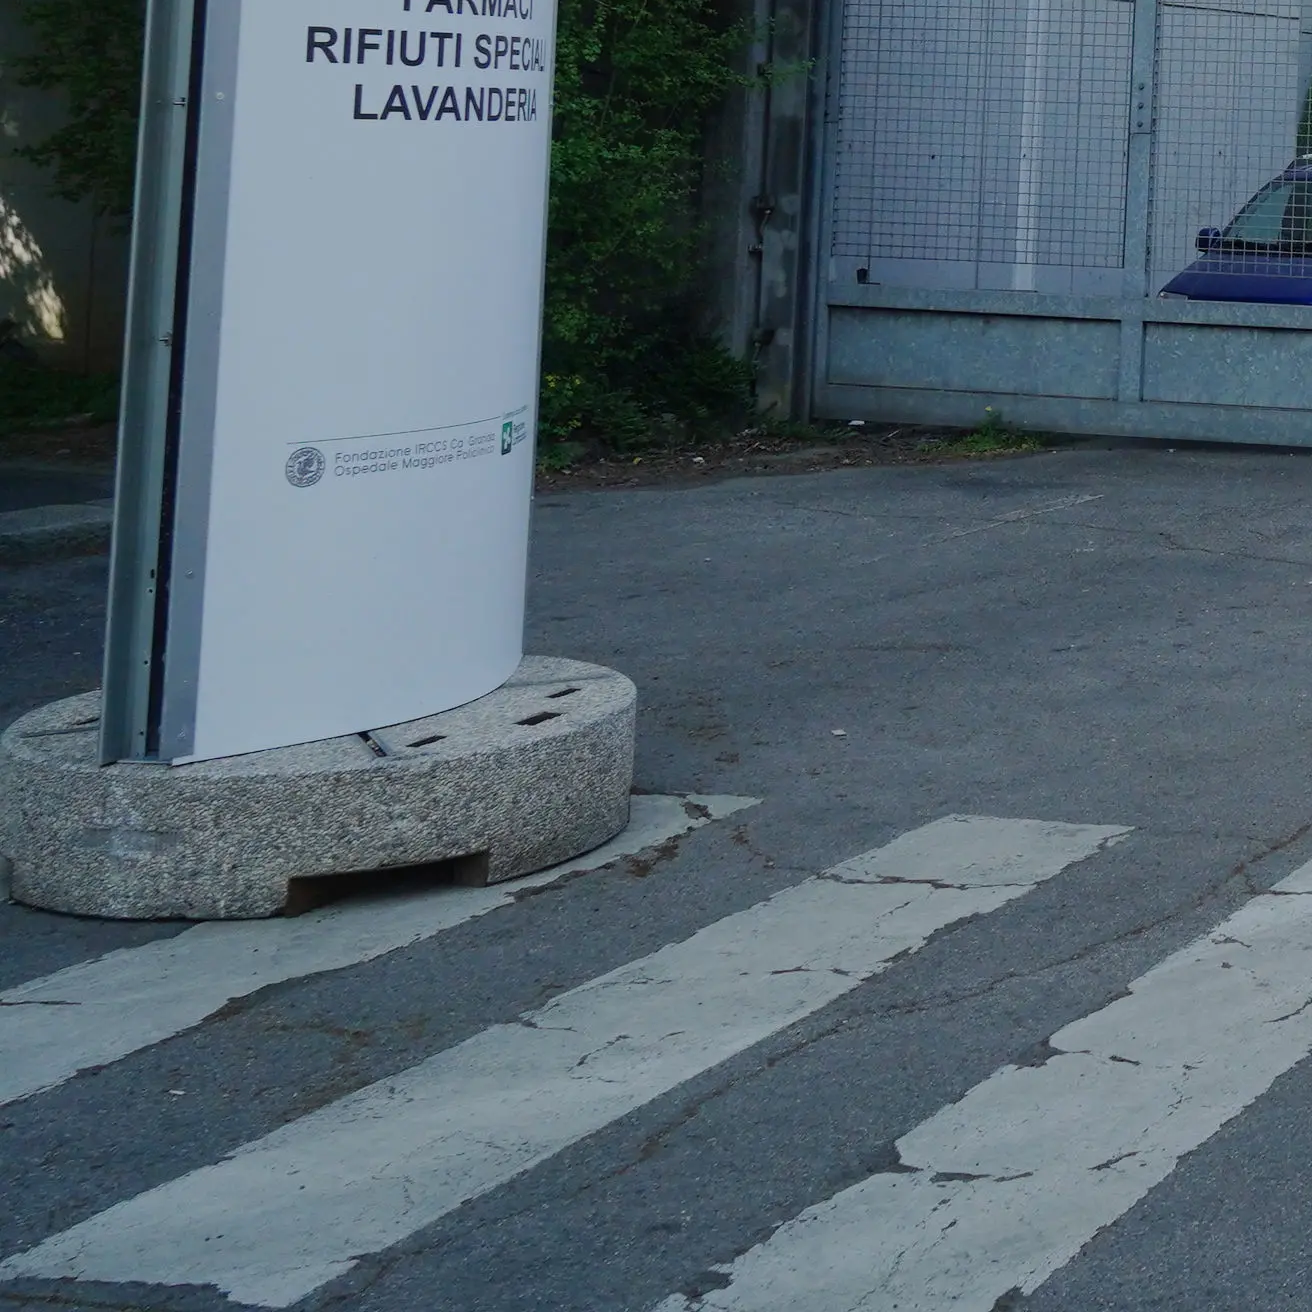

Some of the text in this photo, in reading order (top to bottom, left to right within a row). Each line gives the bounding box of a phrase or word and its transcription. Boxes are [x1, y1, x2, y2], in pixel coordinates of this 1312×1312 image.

[305, 25, 547, 72] RIFIUTI SPECIALI
[353, 83, 538, 122] LAVANDERIA
[334, 461, 398, 479] Ospedale
[402, 452, 454, 470] Maggiore
[335, 447, 411, 463] Fondazione
[415, 439, 448, 455] IRCCS
